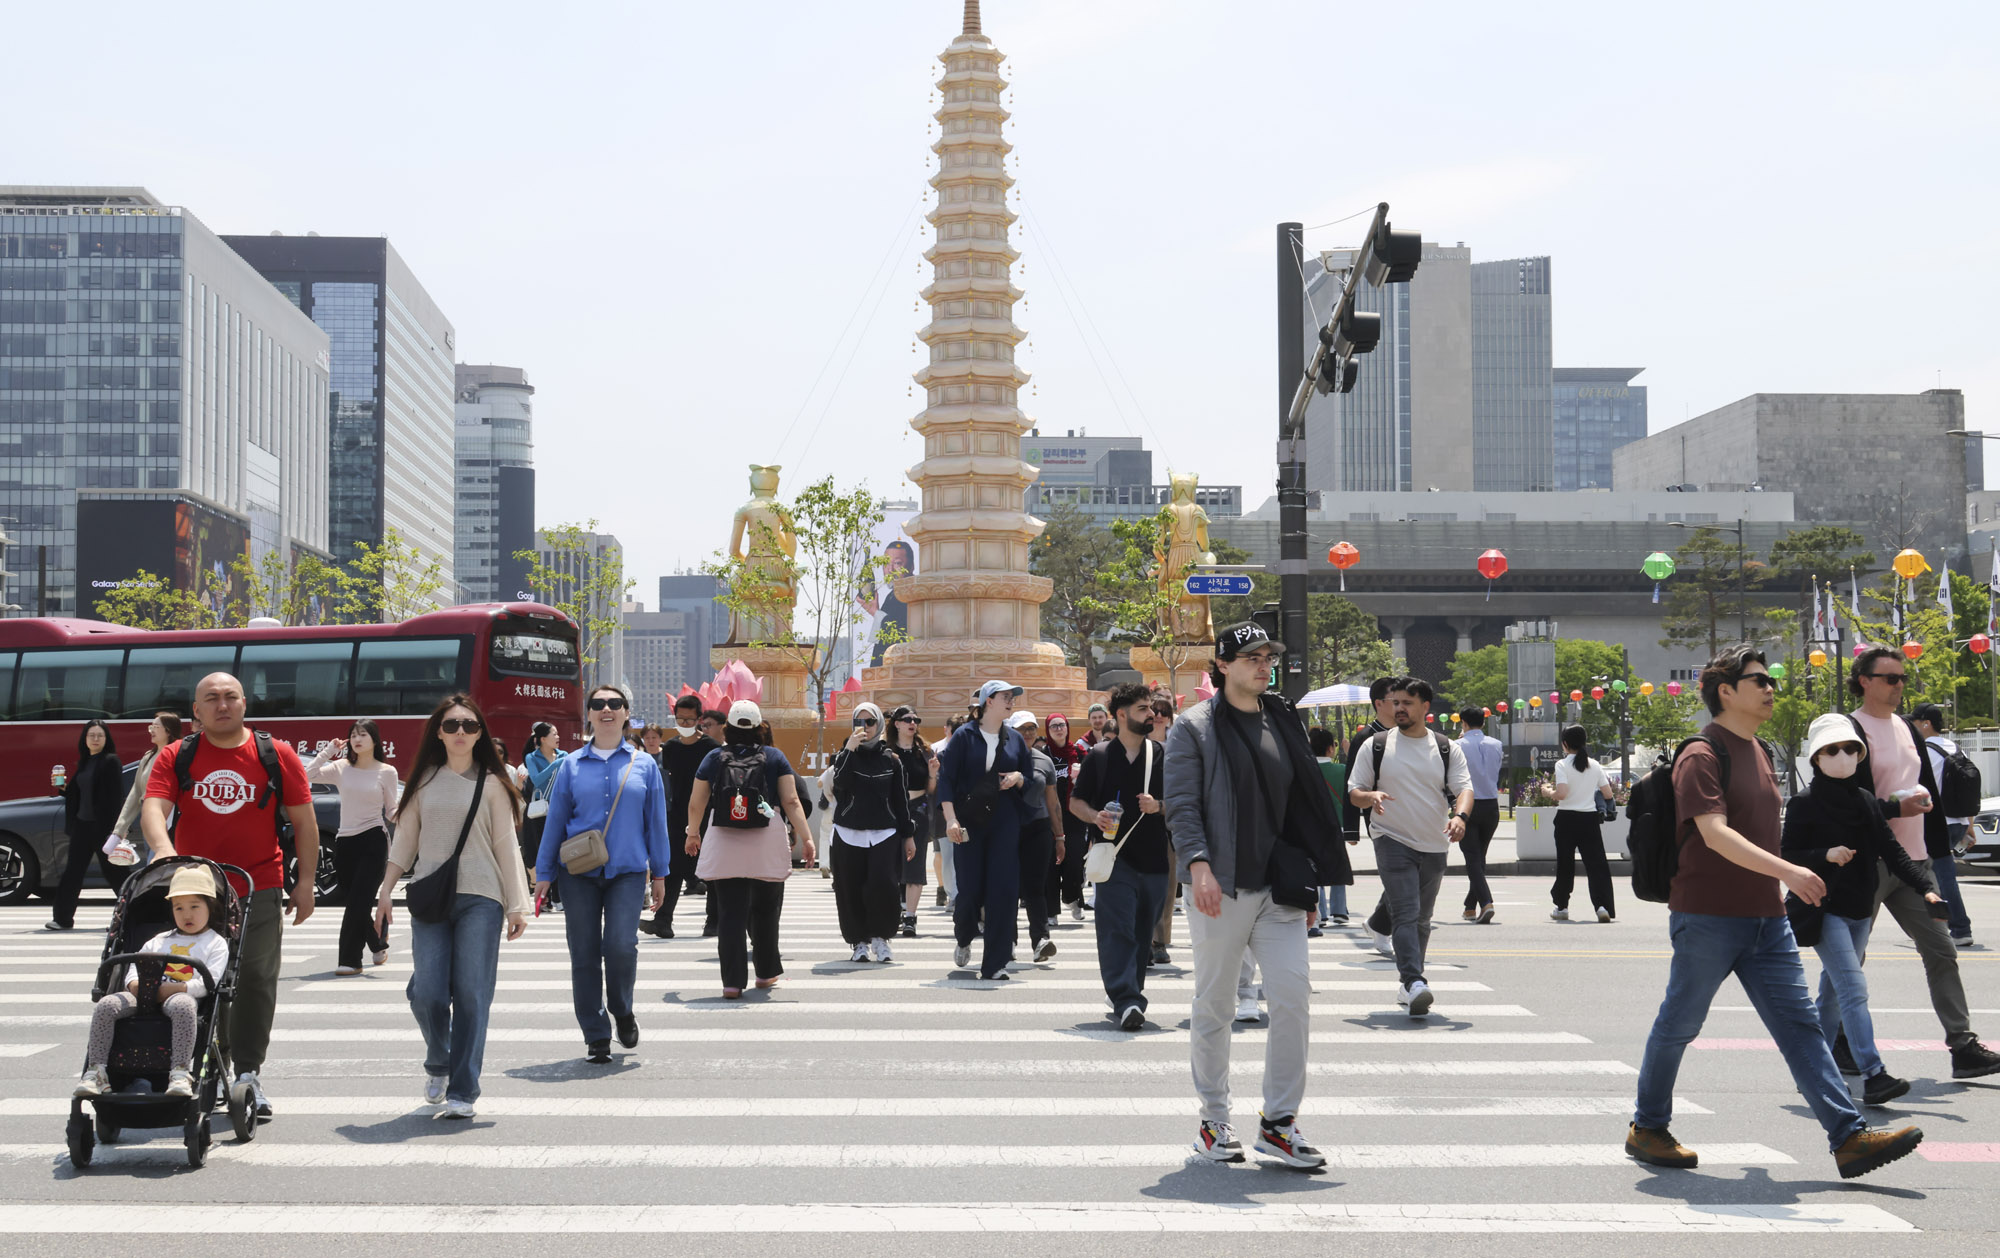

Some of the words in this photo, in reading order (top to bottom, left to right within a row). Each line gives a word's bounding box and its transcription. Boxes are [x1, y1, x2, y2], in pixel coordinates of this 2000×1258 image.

[1578, 384, 1630, 398] OFFICIA
[91, 580, 121, 589] Galaxy
[1208, 578, 1231, 587] 사직로
[193, 783, 257, 801] DUBAI
